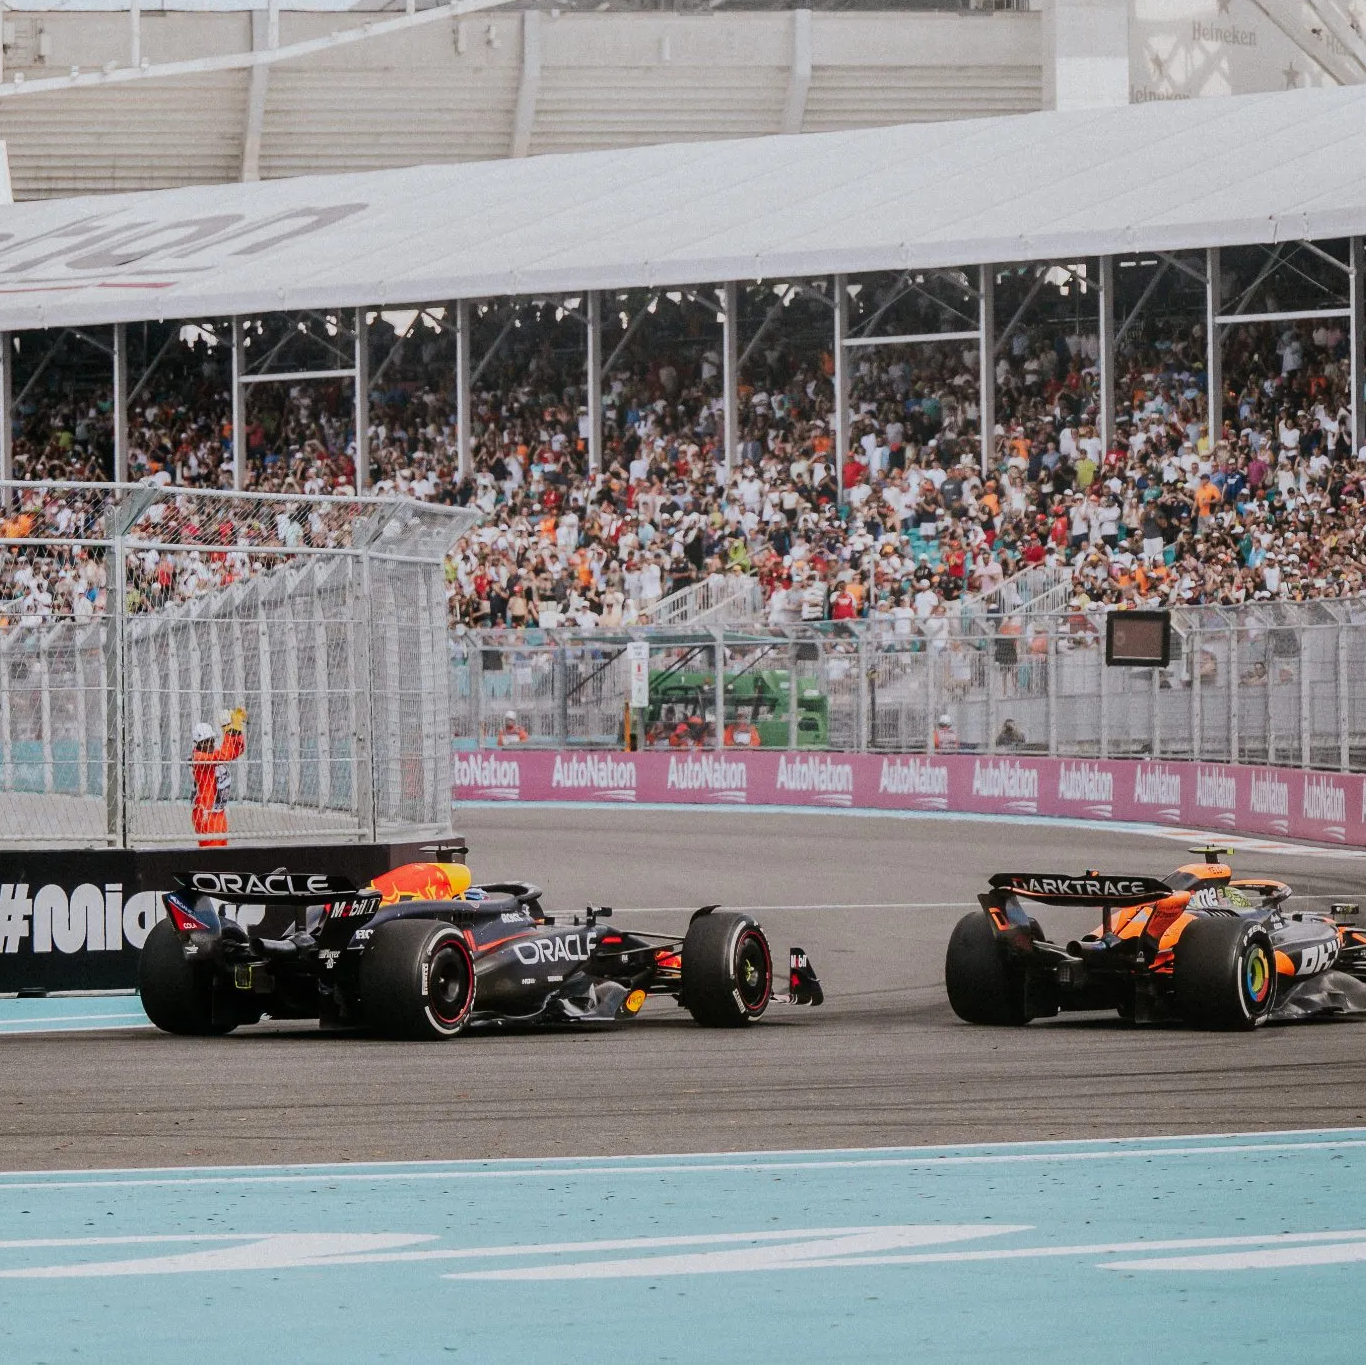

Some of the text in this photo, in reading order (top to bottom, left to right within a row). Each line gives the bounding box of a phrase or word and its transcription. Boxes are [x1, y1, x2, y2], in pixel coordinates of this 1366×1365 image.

[1192, 22, 1257, 47] Heineken
[454, 754, 520, 788] toNation
[552, 755, 636, 788] AutoNation
[668, 755, 747, 790] AutoNation
[776, 756, 853, 792] AutoNation
[879, 758, 948, 795] AutoNation
[972, 759, 1038, 798] AutoNation
[1058, 761, 1113, 801] AutoNation
[1135, 763, 1181, 805] AutoNation
[1196, 766, 1236, 808] AutoNation
[1250, 770, 1289, 816] AutoNation
[1303, 775, 1346, 822] AutoNation
[192, 873, 329, 894] ORACLE
[1012, 878, 1147, 896] DARKTRACE
[330, 899, 368, 919] Mobil
